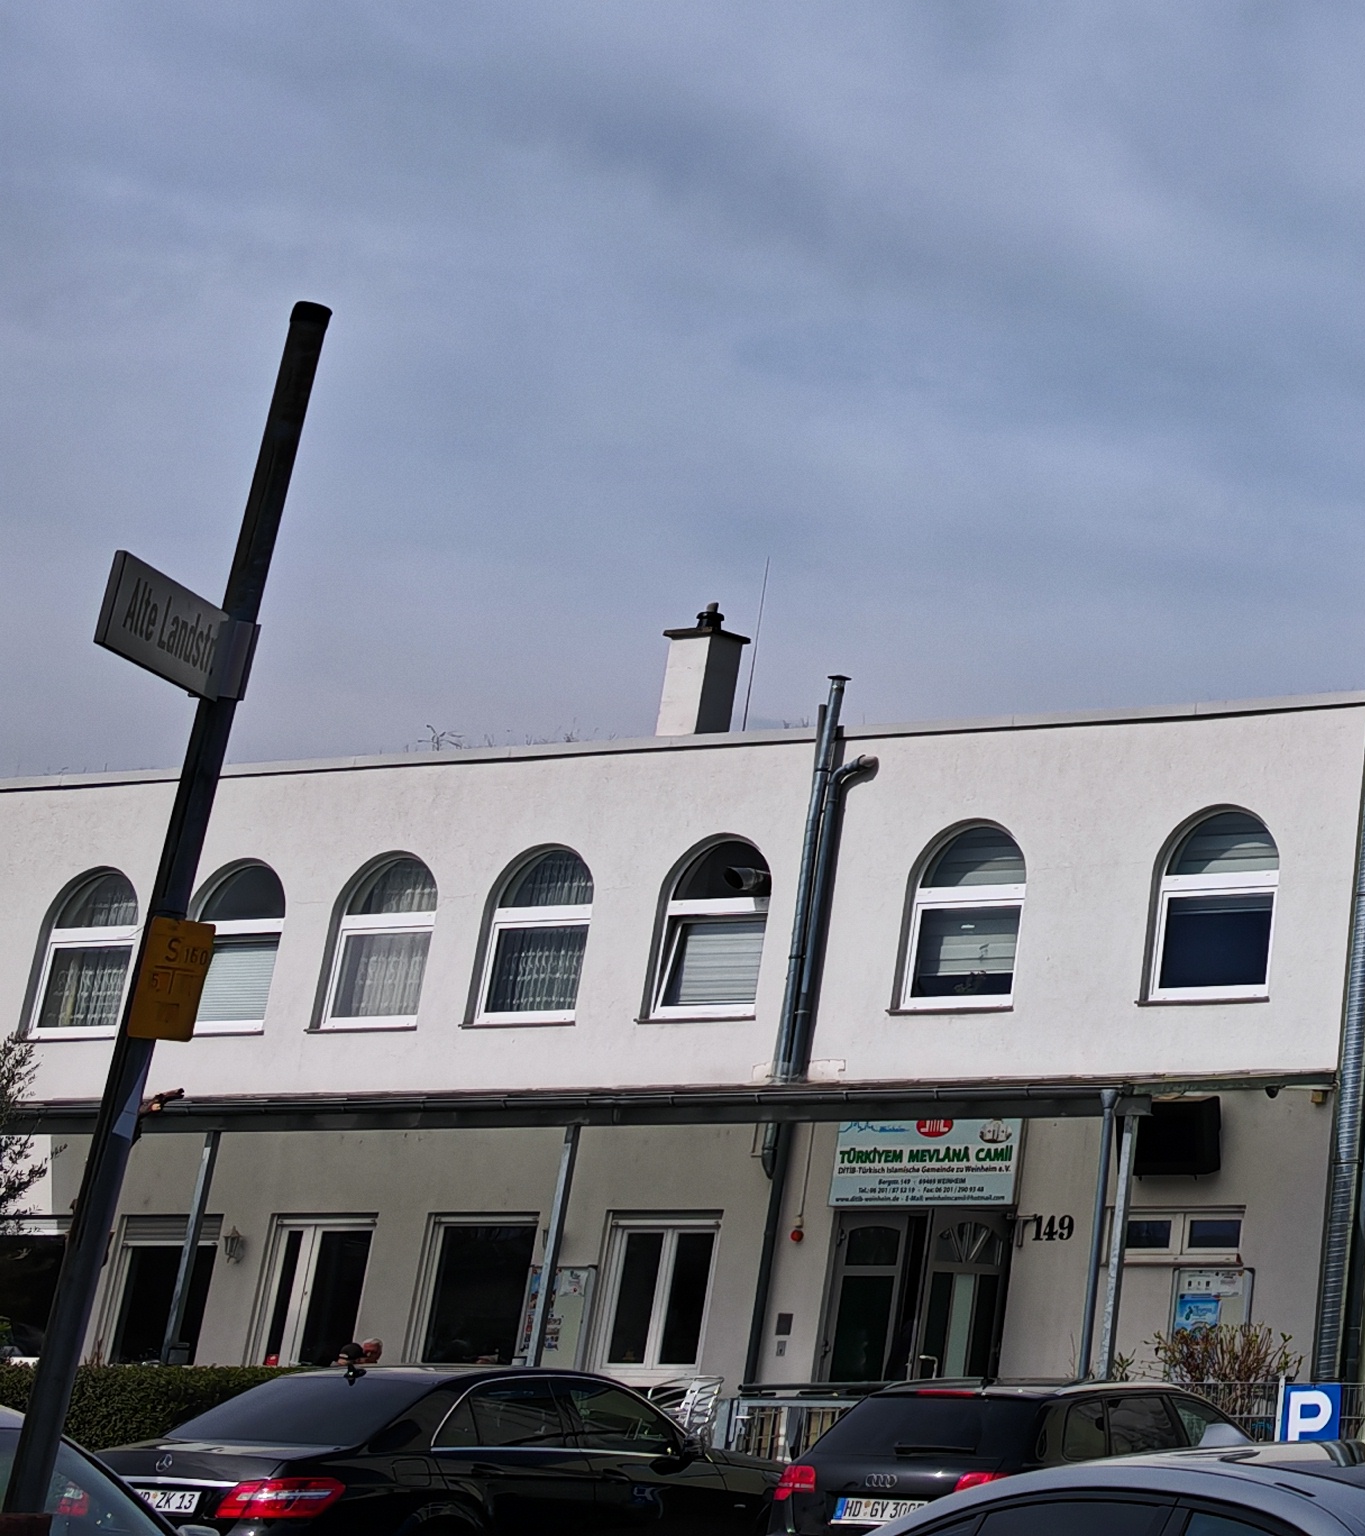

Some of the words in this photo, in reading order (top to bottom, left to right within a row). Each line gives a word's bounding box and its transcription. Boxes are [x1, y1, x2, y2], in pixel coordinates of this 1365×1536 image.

[122, 577, 158, 642] Alte
[165, 937, 182, 962] S
[840, 1147, 903, 1164] TÜRKİYEM
[886, 1165, 920, 1173] Islamische
[921, 1165, 955, 1173] Gemeinde
[964, 1164, 997, 1173] Weinheim
[1032, 1214, 1074, 1241] 149
[1288, 1390, 1332, 1441] P
[155, 1492, 176, 1509] ZK
[175, 1493, 195, 1510] 13
[843, 1500, 862, 1517] HD
[869, 1501, 889, 1518] GY
